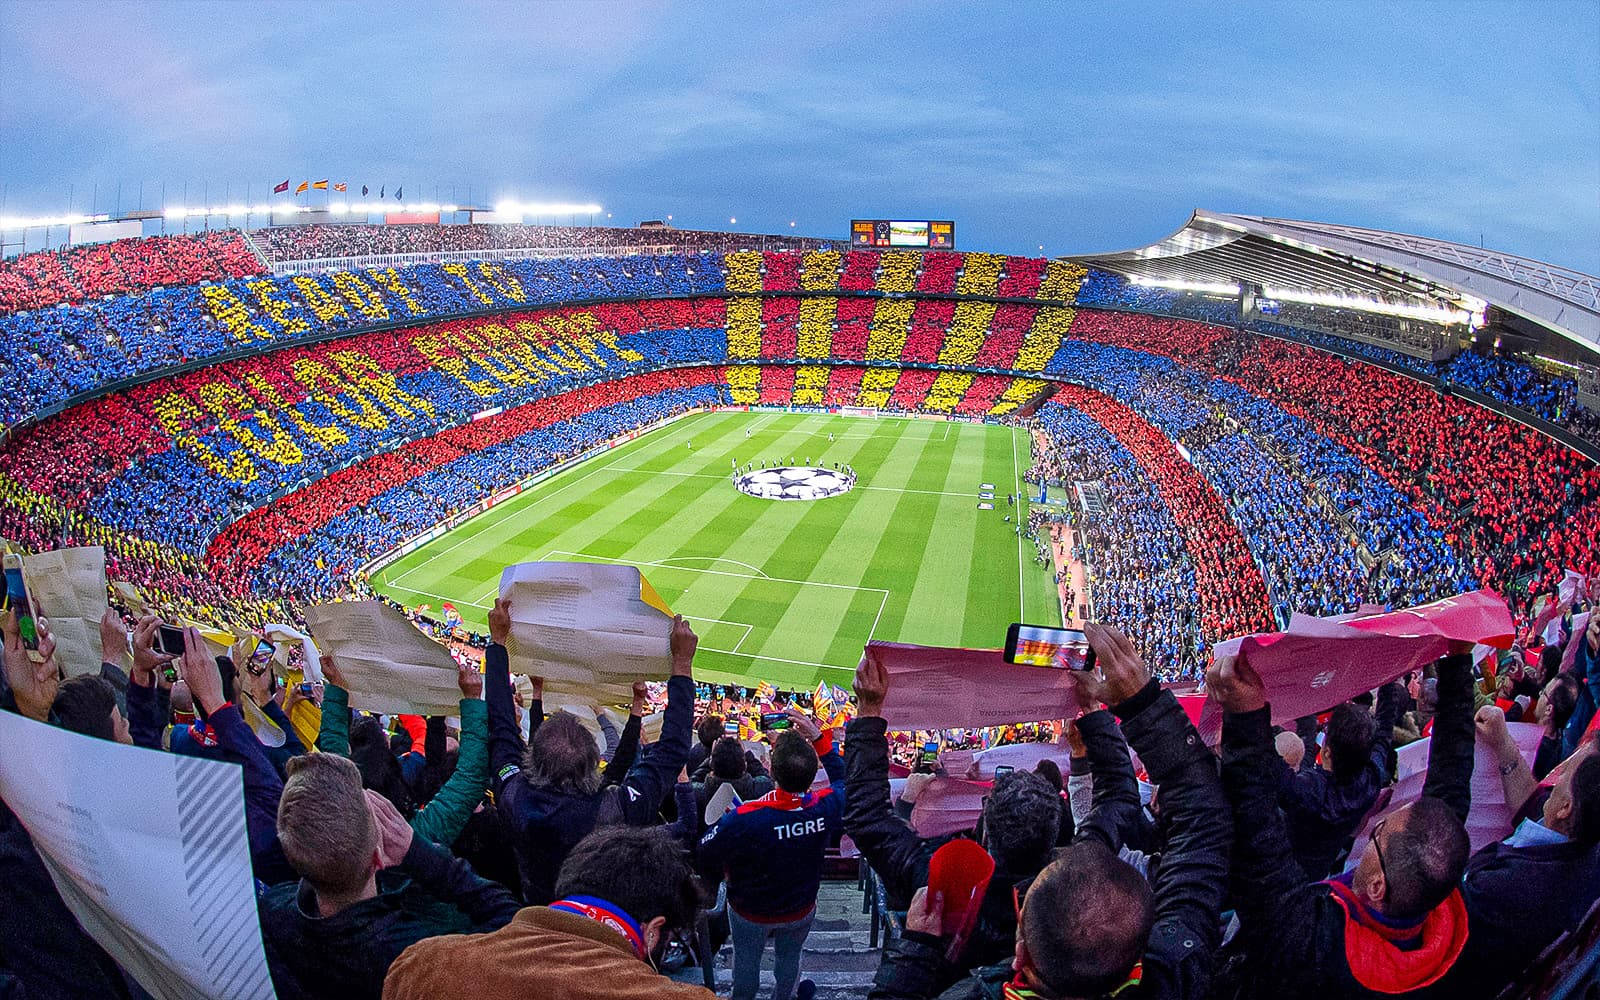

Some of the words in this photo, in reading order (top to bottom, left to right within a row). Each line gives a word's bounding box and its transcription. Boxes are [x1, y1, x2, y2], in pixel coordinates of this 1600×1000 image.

[202, 267, 428, 343] READY
[443, 262, 526, 305] TO
[153, 350, 435, 484] COLOR
[409, 311, 644, 396] EUROPE
[773, 817, 826, 840] TIGRE
